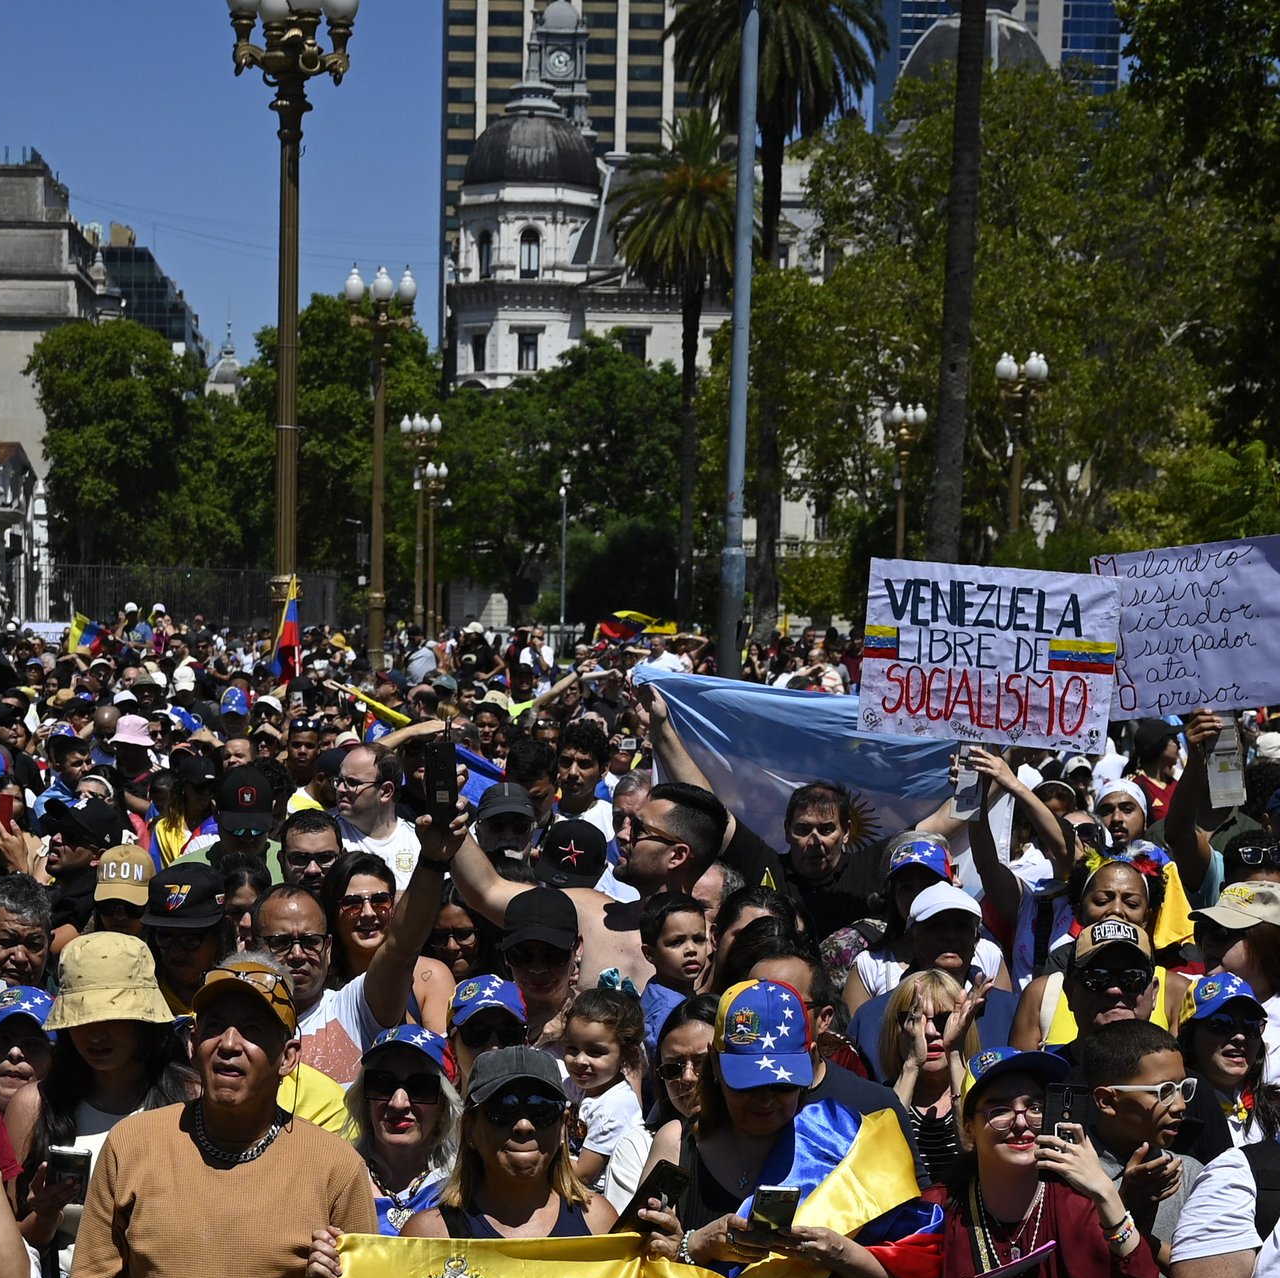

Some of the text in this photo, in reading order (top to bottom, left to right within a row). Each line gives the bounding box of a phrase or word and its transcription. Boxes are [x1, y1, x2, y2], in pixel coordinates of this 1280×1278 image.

[884, 578, 1083, 638] VENEZUELA
[895, 629, 1054, 675] LIBRE DE
[881, 664, 1089, 736] SOCIALISMO
[103, 862, 143, 881] ICON
[1093, 921, 1137, 942] EVERLAST
